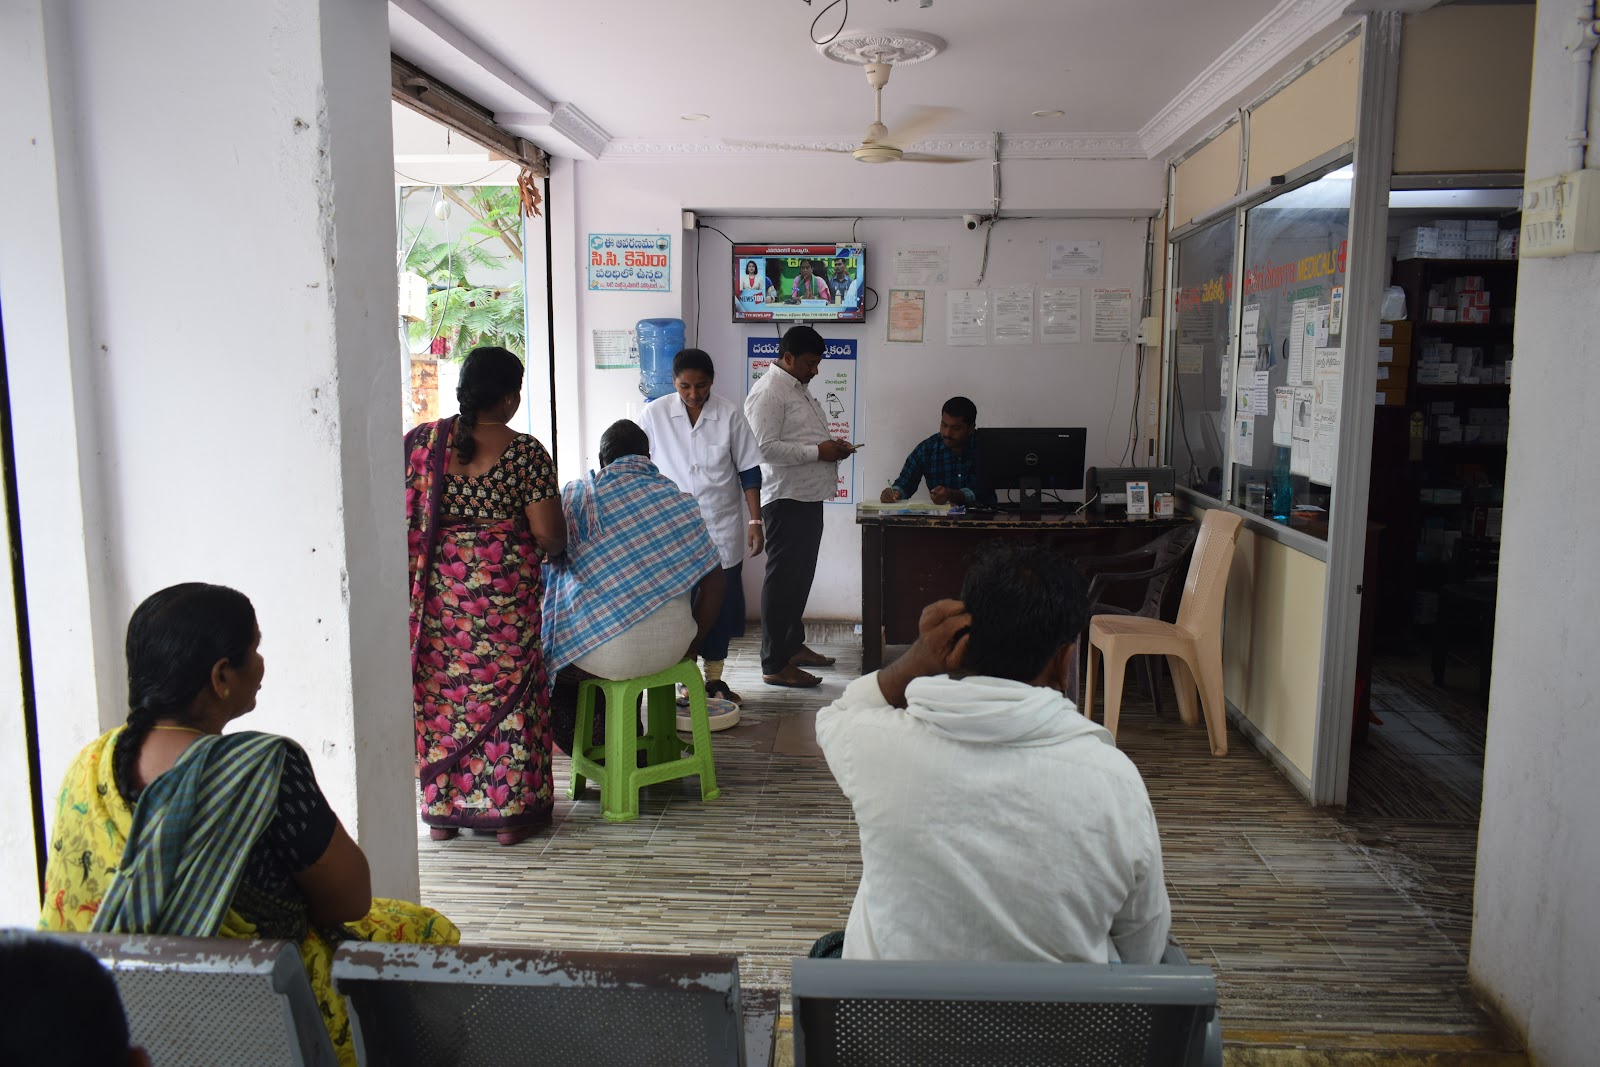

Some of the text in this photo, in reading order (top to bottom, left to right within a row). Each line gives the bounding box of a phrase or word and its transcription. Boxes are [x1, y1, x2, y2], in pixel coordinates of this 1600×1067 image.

[605, 238, 654, 249] ఈ ఆవరణము
[591, 251, 667, 267] సి.సి. కెమెరా
[1297, 249, 1337, 282] MEDICALS
[595, 267, 663, 282] పరిధిలో ఉన్నది
[754, 294, 764, 302] 100
[752, 343, 780, 354] దయచే
